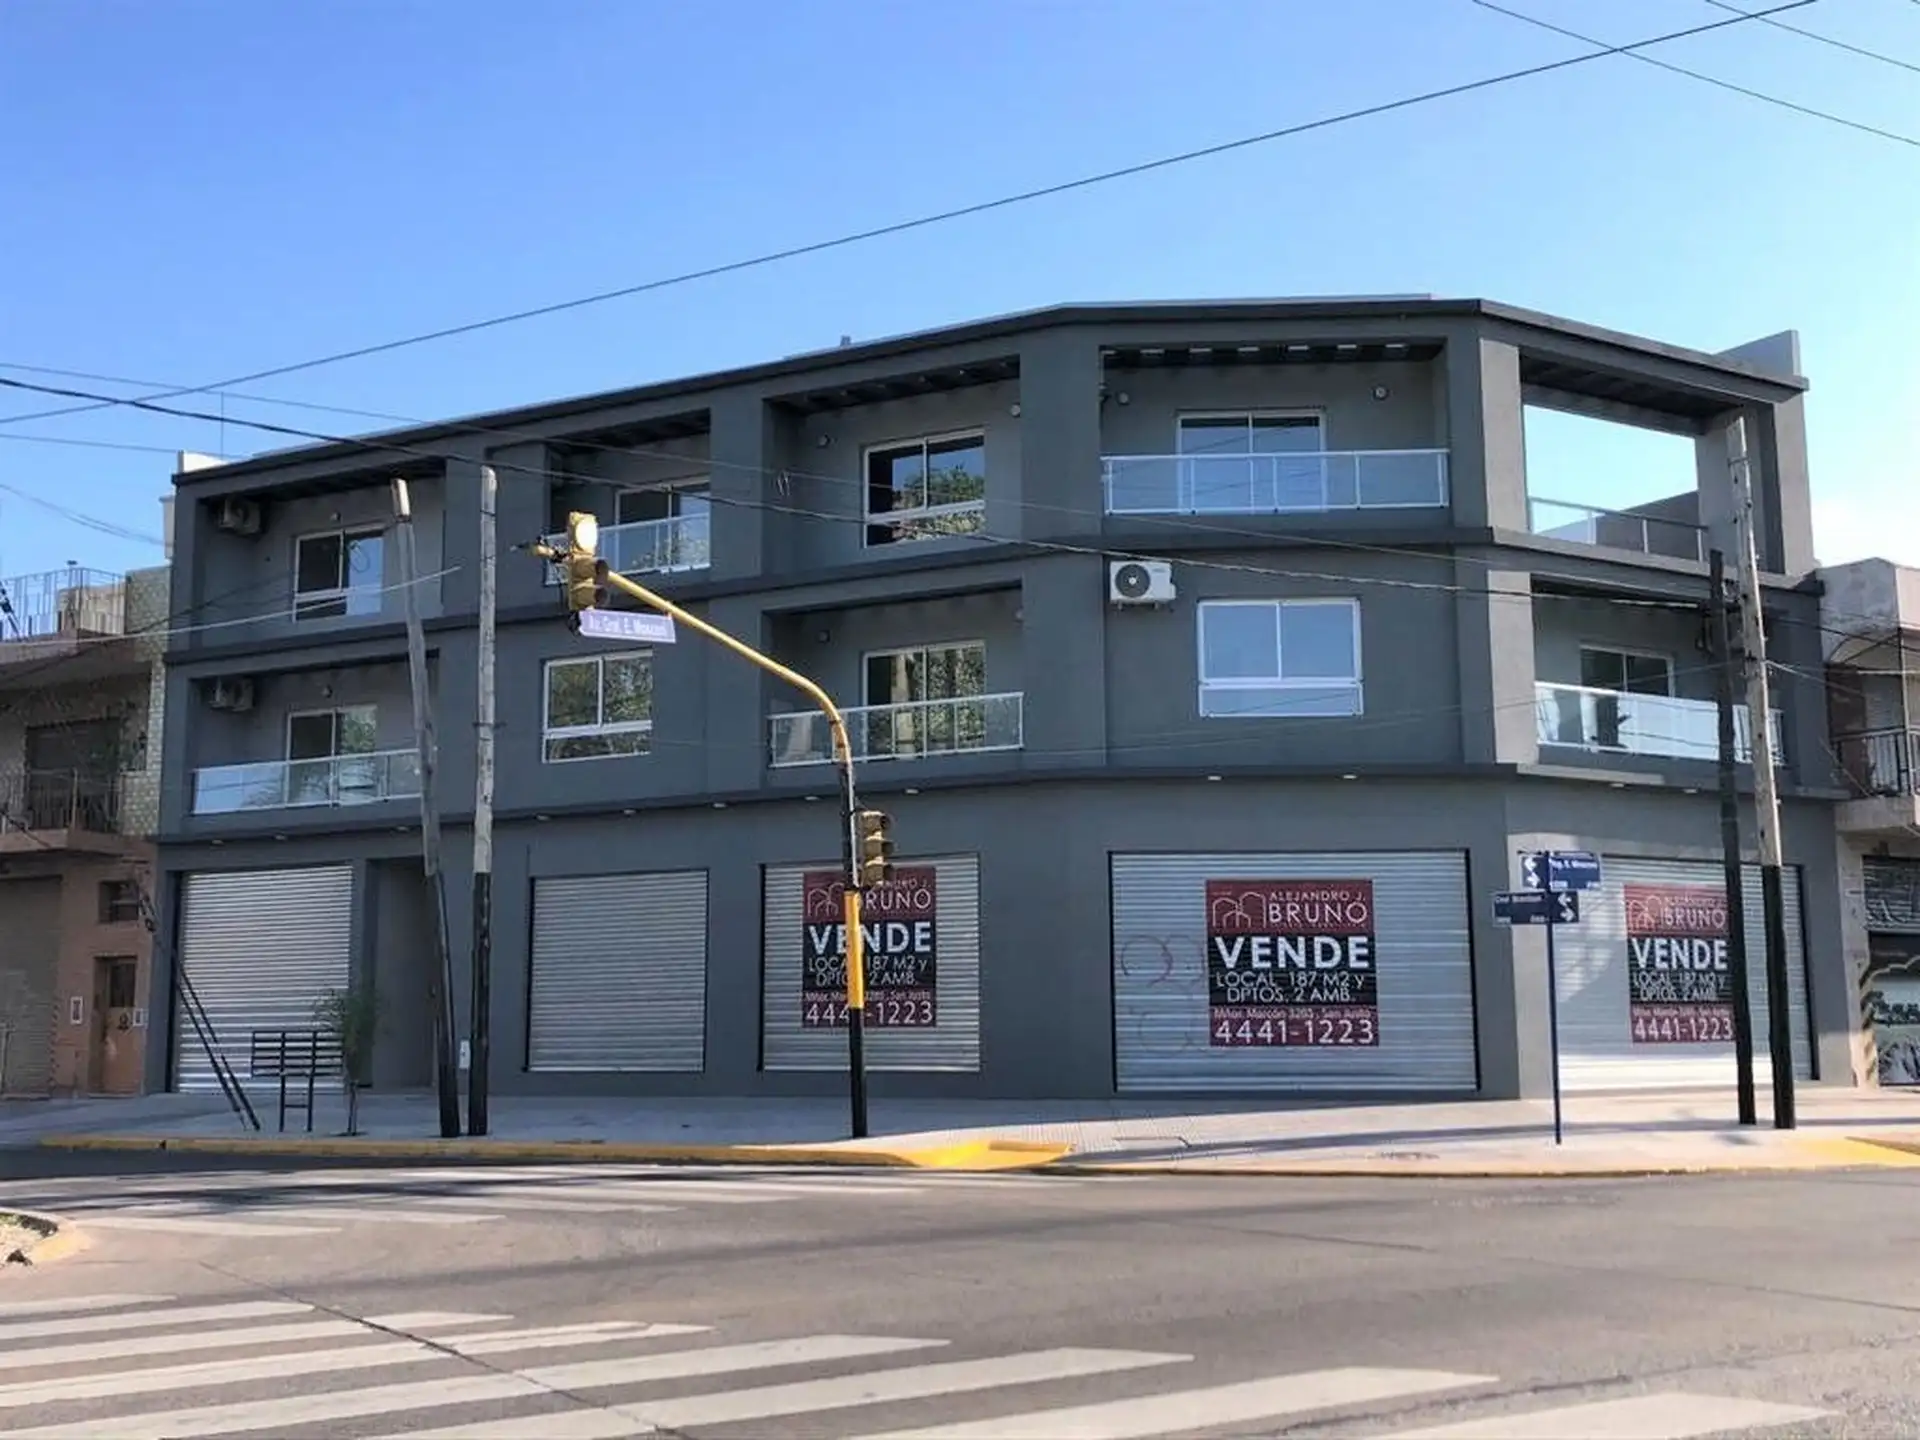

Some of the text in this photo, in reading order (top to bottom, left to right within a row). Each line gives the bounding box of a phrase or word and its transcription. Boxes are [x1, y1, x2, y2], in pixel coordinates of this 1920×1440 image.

[865, 888, 932, 911] RUNO
[1269, 891, 1366, 902] ALEJANDRO J.
[1269, 902, 1368, 923] BRUNO
[1665, 907, 1727, 929] BRUNO
[1214, 935, 1369, 969] VENDE
[1632, 937, 1728, 970] VENDE
[894, 956, 916, 971] M2
[1216, 972, 1276, 988] LOCAL
[1290, 972, 1316, 987] 187
[1322, 971, 1350, 988] M2
[1294, 988, 1305, 1003] 2
[806, 1002, 933, 1025] 444-1223
[1214, 1019, 1374, 1045] 4441-1223
[1634, 1018, 1733, 1041] 4441-1223
